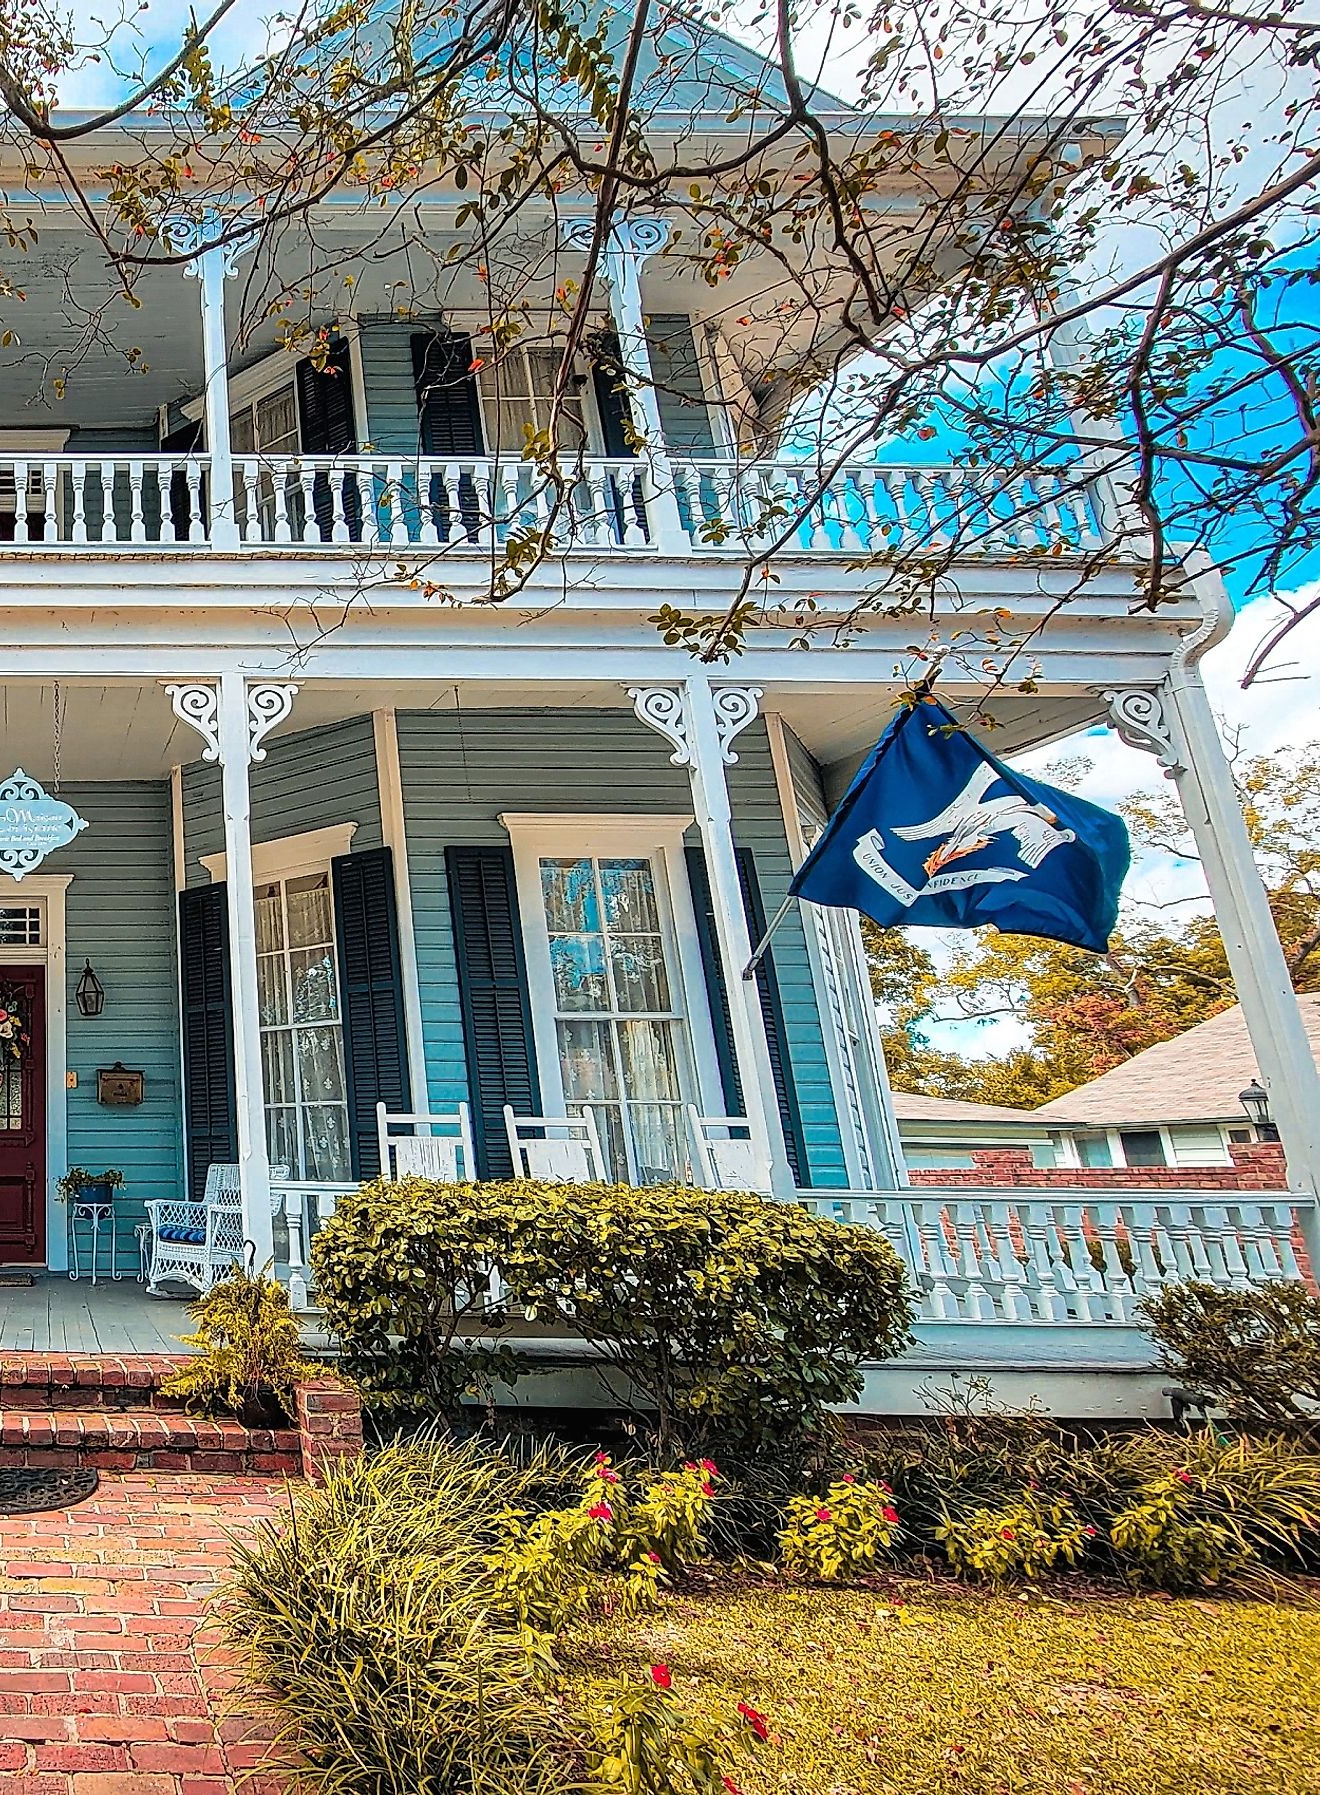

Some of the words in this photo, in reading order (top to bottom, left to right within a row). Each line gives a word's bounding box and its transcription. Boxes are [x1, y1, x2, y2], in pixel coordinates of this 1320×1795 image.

[862, 852, 888, 880] UNION
[891, 883, 914, 902] JUS
[927, 873, 982, 889] NFIDENCE
